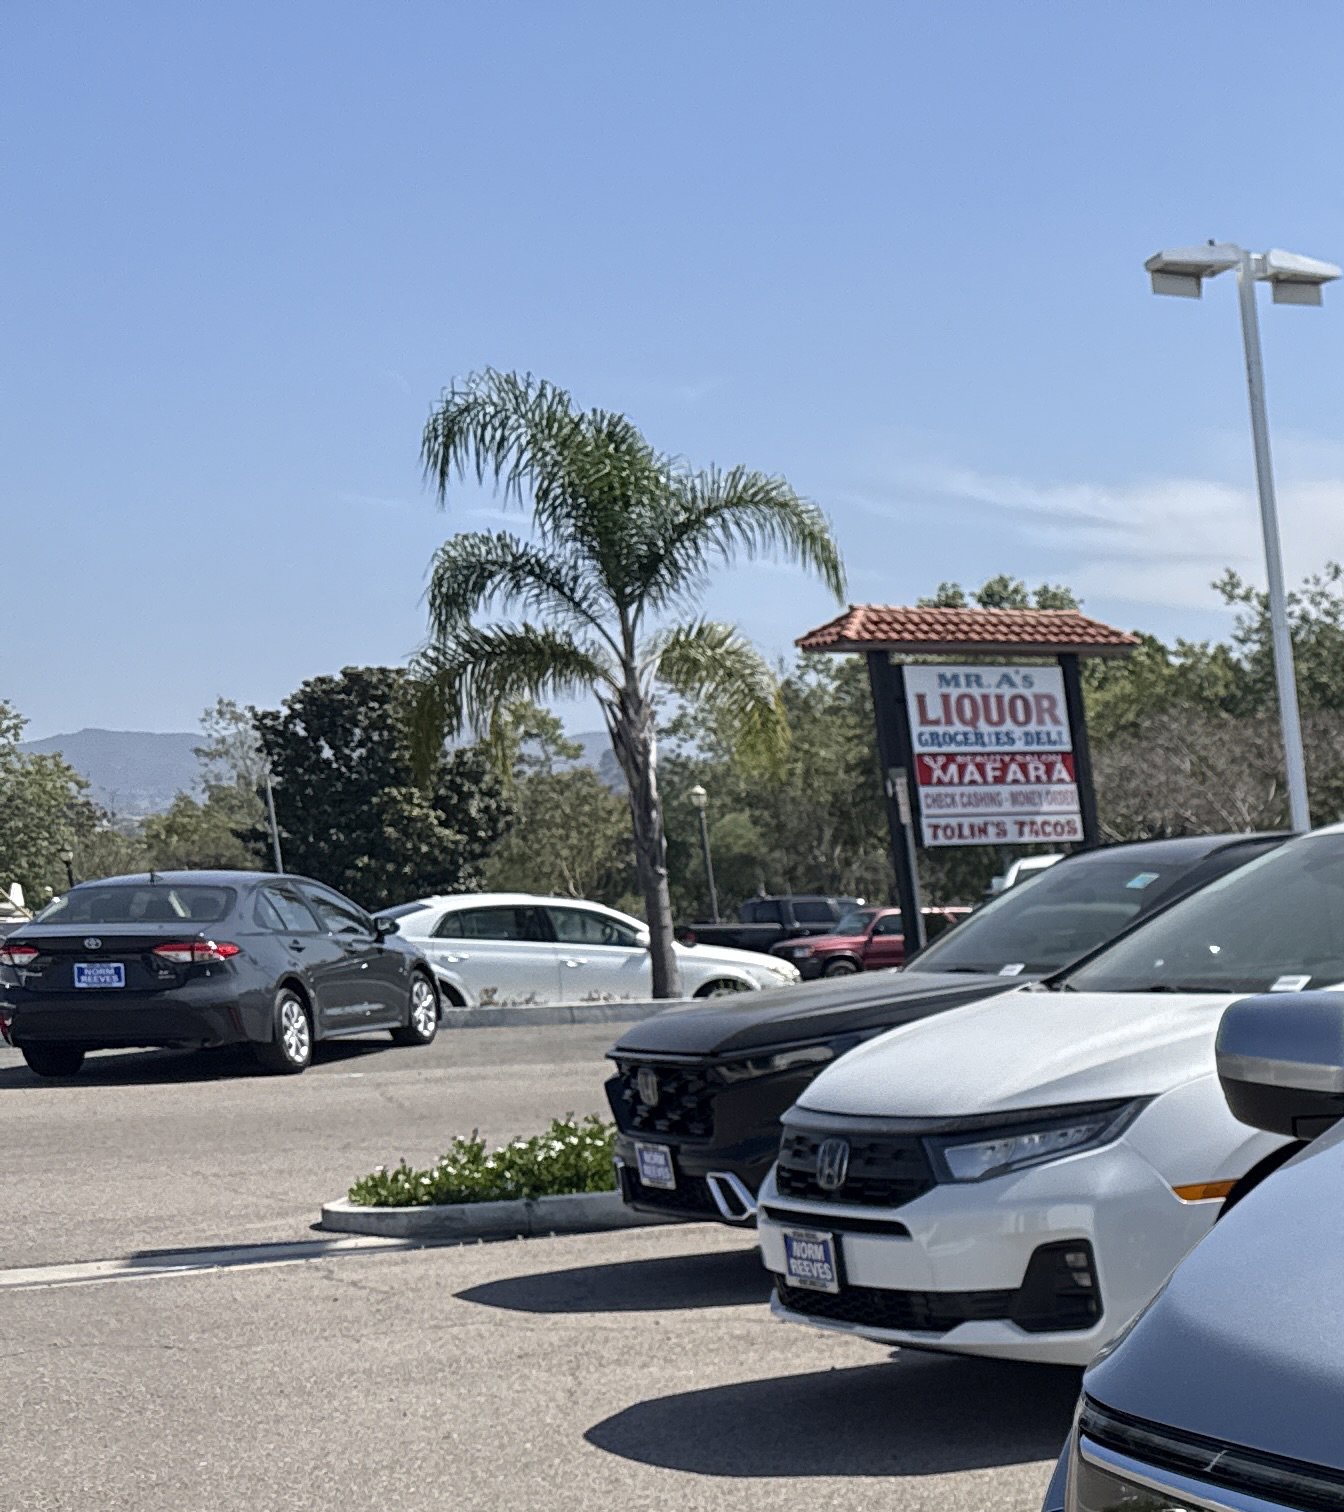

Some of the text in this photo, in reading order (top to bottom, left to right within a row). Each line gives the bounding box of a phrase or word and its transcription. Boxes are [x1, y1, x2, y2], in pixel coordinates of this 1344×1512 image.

[915, 692, 1063, 731] LIQUOR
[917, 730, 1065, 748] GROCERIES DELI
[932, 763, 1072, 785] MAFARA
[1014, 818, 1078, 838] TACOS
[84, 968, 115, 976] NORM
[792, 1240, 825, 1261] NORM
[790, 1257, 832, 1281] REEVES
